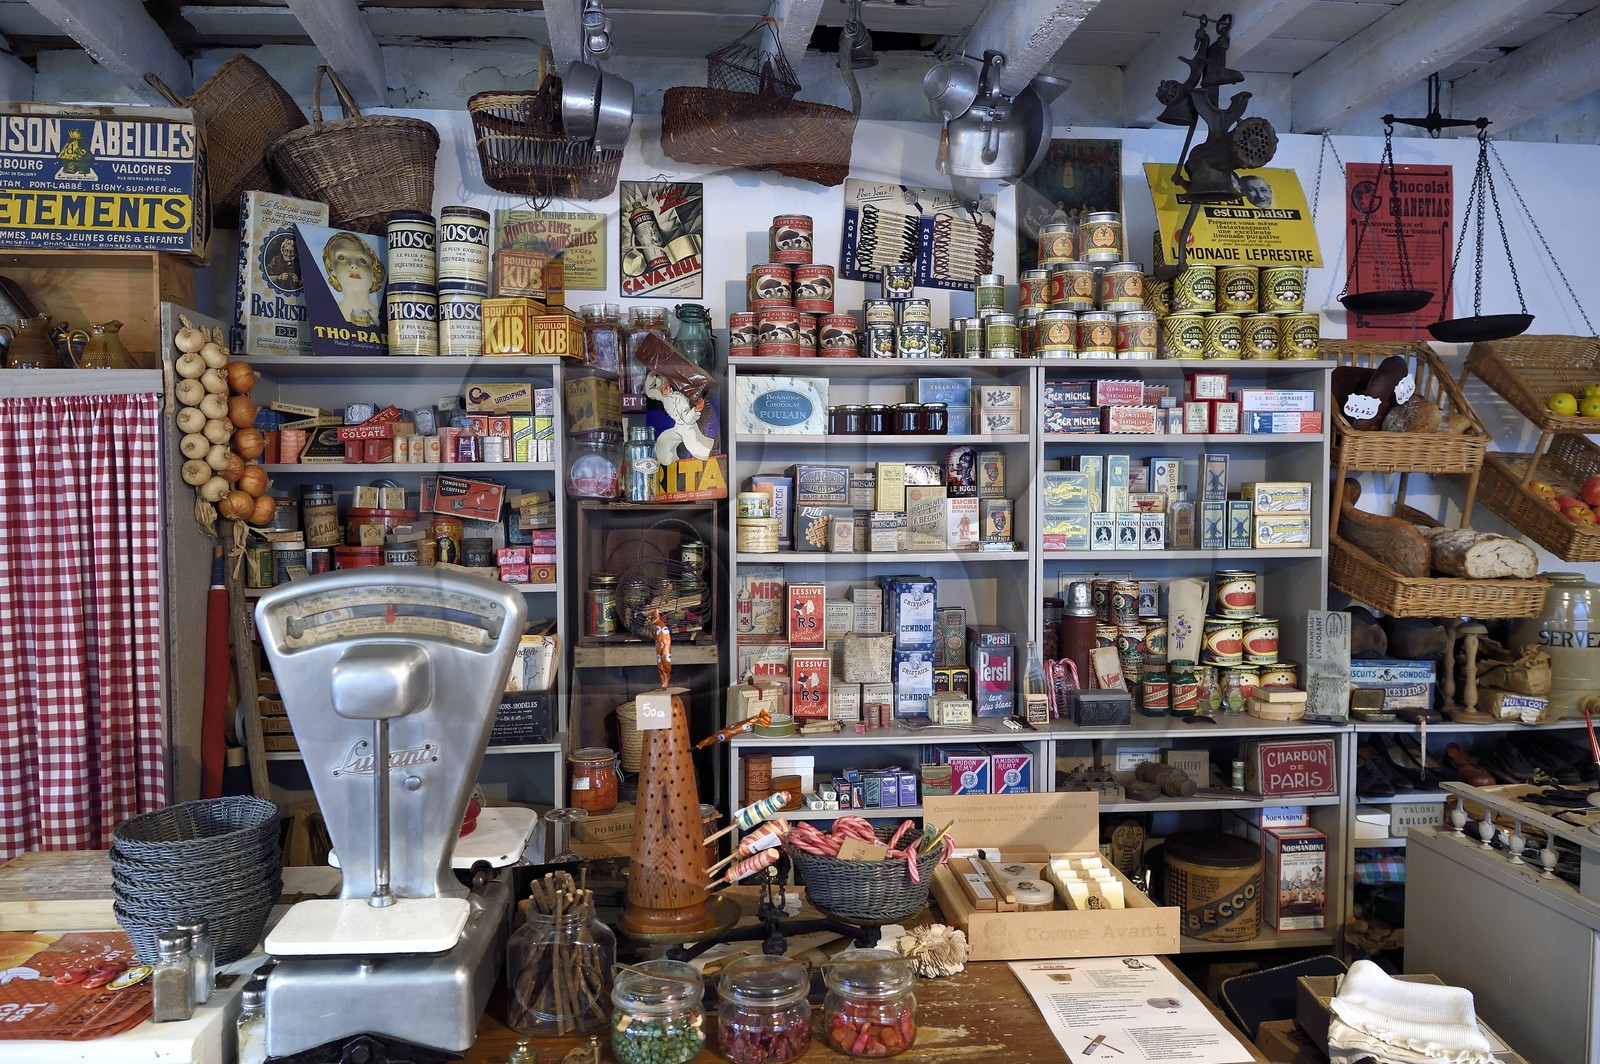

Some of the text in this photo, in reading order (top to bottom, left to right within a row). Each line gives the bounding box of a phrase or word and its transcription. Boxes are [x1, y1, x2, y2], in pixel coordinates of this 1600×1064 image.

[91, 120, 195, 158] ABEILLES
[0, 159, 43, 170] BOURG
[112, 164, 171, 175] VALOGNES
[92, 184, 166, 193] ISIGNY-SUR-MER
[1389, 180, 1450, 194] Chocolat
[1213, 208, 1294, 225] est un plaisir
[548, 220, 572, 235] FINES
[1207, 219, 1236, 229] Préparez
[66, 234, 104, 242] JEUNES
[107, 235, 132, 243] GENS
[144, 236, 184, 245] ENFANTS
[546, 231, 598, 252] COURSEULLES
[845, 243, 854, 277] LACET
[919, 228, 931, 285] MON LACET
[1172, 247, 1315, 263] LMONADE LEPRESTRE
[504, 257, 543, 268] BOUILLON
[503, 265, 544, 289] KUB
[250, 293, 274, 318] BAS
[484, 307, 524, 317] BOUILLON
[535, 322, 567, 330] BOUILLON
[485, 317, 525, 355] KUB
[535, 330, 567, 354] KUB
[623, 397, 638, 406] ET
[765, 400, 800, 408] CHOCOLAT
[760, 411, 807, 419] POULAIN
[342, 431, 386, 440] COLGATE
[1168, 463, 1176, 493] BOUGIES
[441, 479, 469, 489] TONDEUSE
[851, 480, 875, 488] PHOSCAO
[920, 512, 944, 524] BEGHIN
[871, 521, 897, 529] PHOSCAO
[903, 599, 931, 608] CRISTAUX
[901, 624, 932, 632] CENDROL
[987, 634, 1011, 645] Persil
[1315, 616, 1323, 660] L'AFFOLANT
[796, 661, 828, 670] LESSIVE
[980, 651, 1011, 686] Persil
[901, 667, 929, 676] CRISTAUX
[1398, 671, 1432, 679] GONDOLO
[988, 693, 1003, 702] lave
[980, 700, 1012, 714] plus blanc
[951, 759, 977, 767] AMIDON
[996, 757, 1020, 766] AMIDON
[1267, 750, 1328, 768] CHARBON
[955, 766, 973, 774] REMY
[998, 764, 1017, 772] REMY
[1270, 771, 1323, 789] PARIS
[1404, 806, 1436, 814] TALONS
[1265, 814, 1304, 822] NORMANDINE
[1399, 816, 1440, 825] BULLDOG
[1281, 844, 1325, 853] NORMANDINE
[1188, 883, 1255, 930] BECCO
[1025, 921, 1167, 941] Comme Avant
